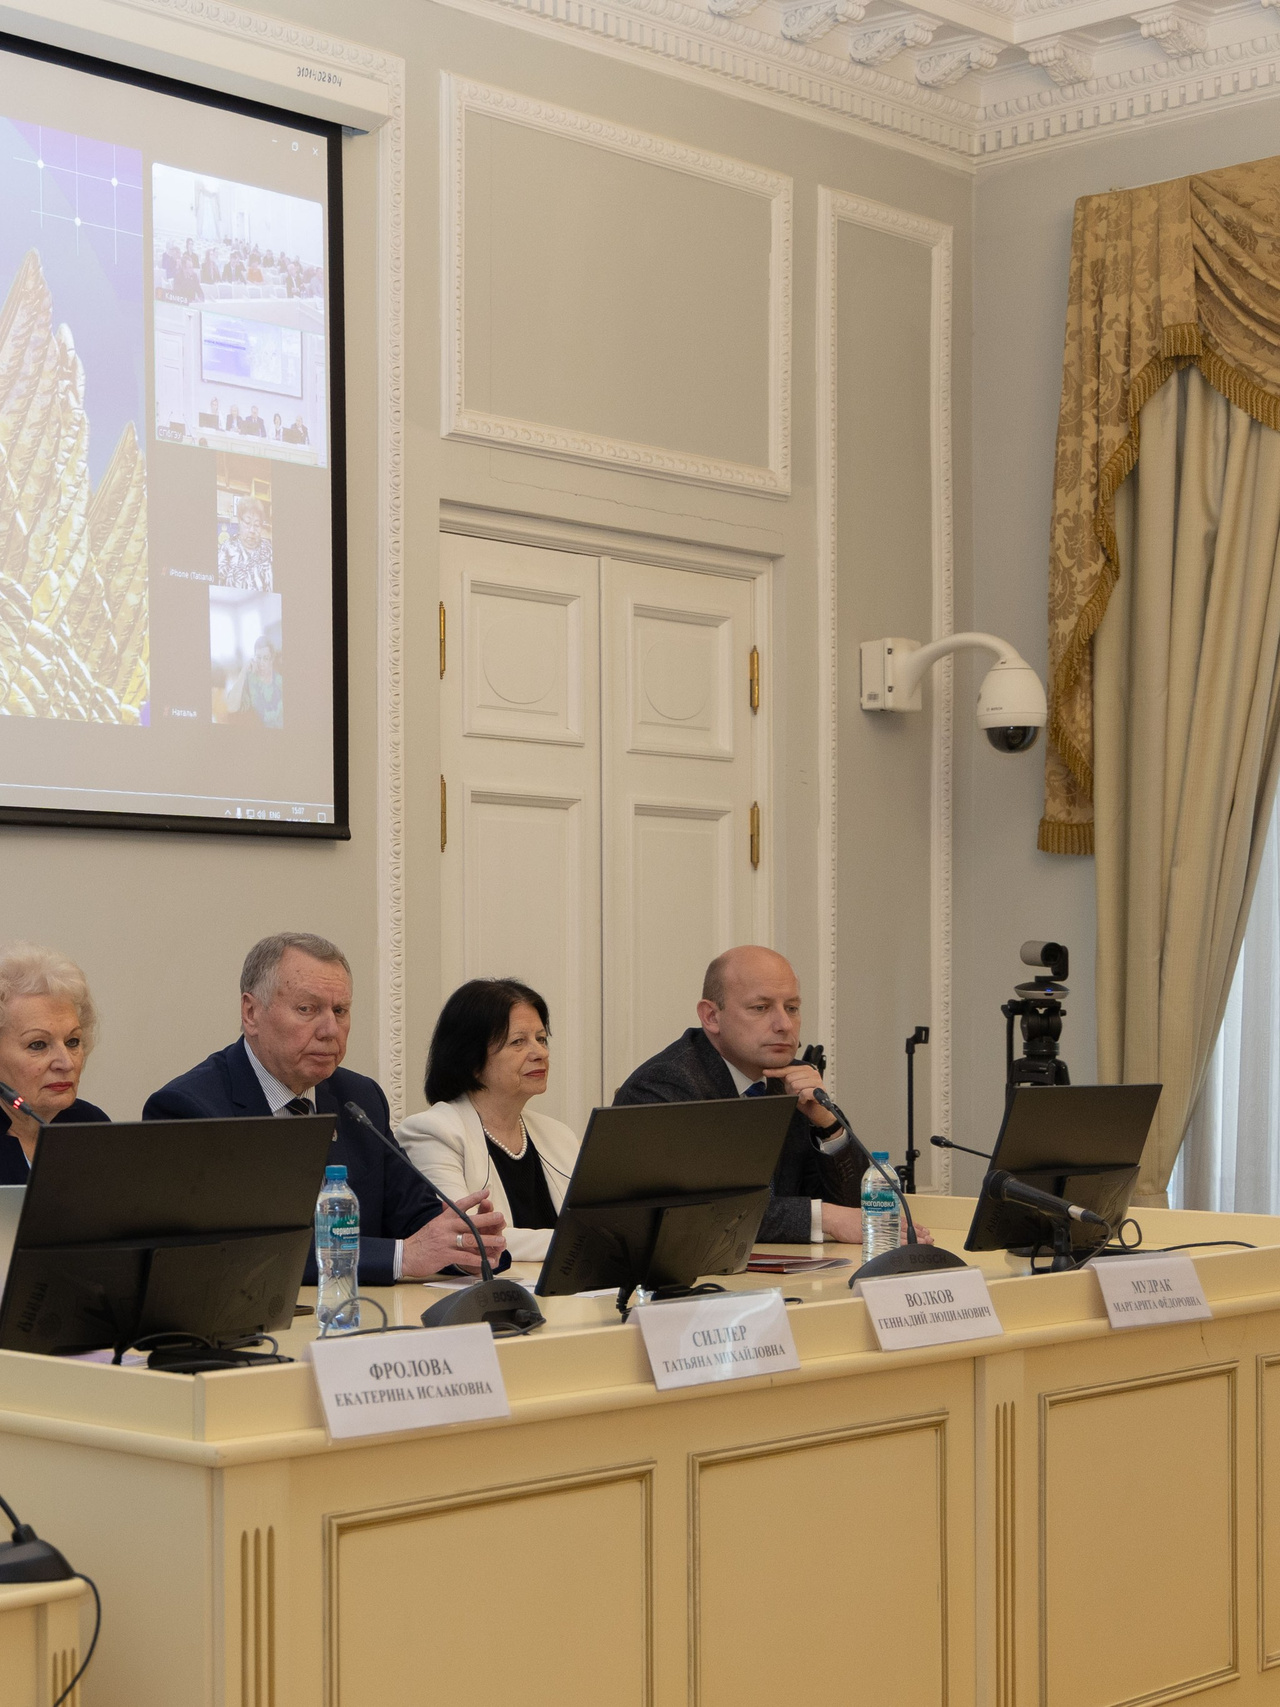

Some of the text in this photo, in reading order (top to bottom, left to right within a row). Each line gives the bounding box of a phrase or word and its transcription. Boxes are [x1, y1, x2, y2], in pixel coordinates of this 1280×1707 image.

[172, 708, 198, 718] Наталья
[1131, 1278, 1173, 1294] МУДРАК
[904, 1288, 955, 1308] ВОЛКОВ
[1113, 1296, 1202, 1313] МАРГАРИТА ФЁДОРОВНА
[878, 1306, 992, 1330] ГЕННАДИЙ ЛЮЦИАНОВИЧ
[692, 1325, 747, 1348] СИЛЛЕР
[368, 1358, 454, 1380] ФРОЛОВА
[662, 1344, 786, 1373] ТАТЬЯНА МИХАЙЛОВНА
[334, 1381, 493, 1407] ЕКАТЕРИНА ИСААКОВНА
